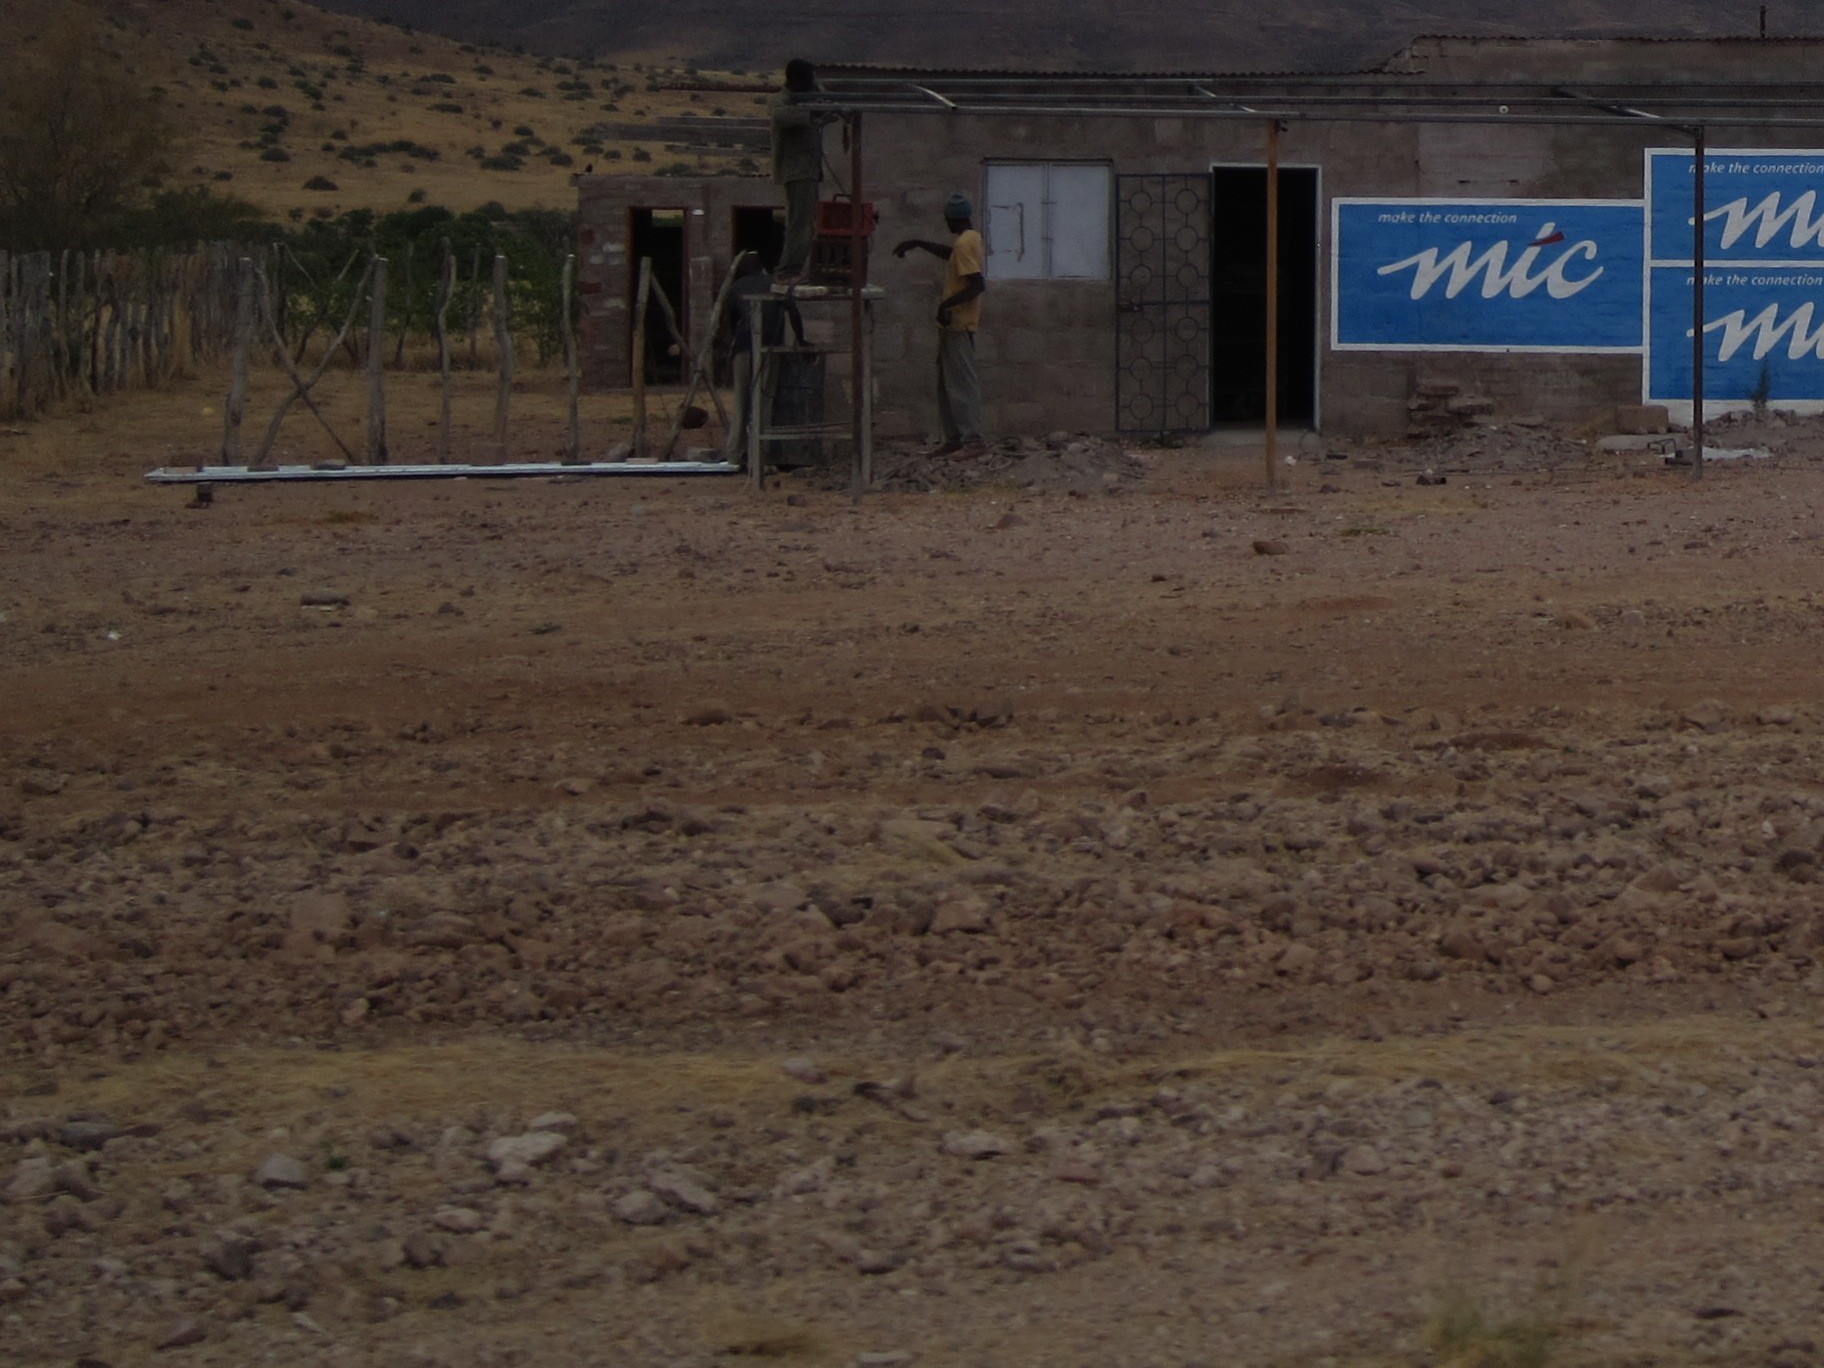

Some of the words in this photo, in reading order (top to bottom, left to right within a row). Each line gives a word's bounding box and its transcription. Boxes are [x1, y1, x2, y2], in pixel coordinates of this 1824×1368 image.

[1689, 162, 1724, 174] make
[1729, 162, 1750, 174] the
[1753, 162, 1824, 174] connection
[1378, 212, 1415, 224] make
[1419, 212, 1440, 224] the
[1444, 211, 1517, 224] connection
[1377, 222, 1604, 299] mic
[1727, 273, 1747, 286] the
[1752, 273, 1823, 286] connection
